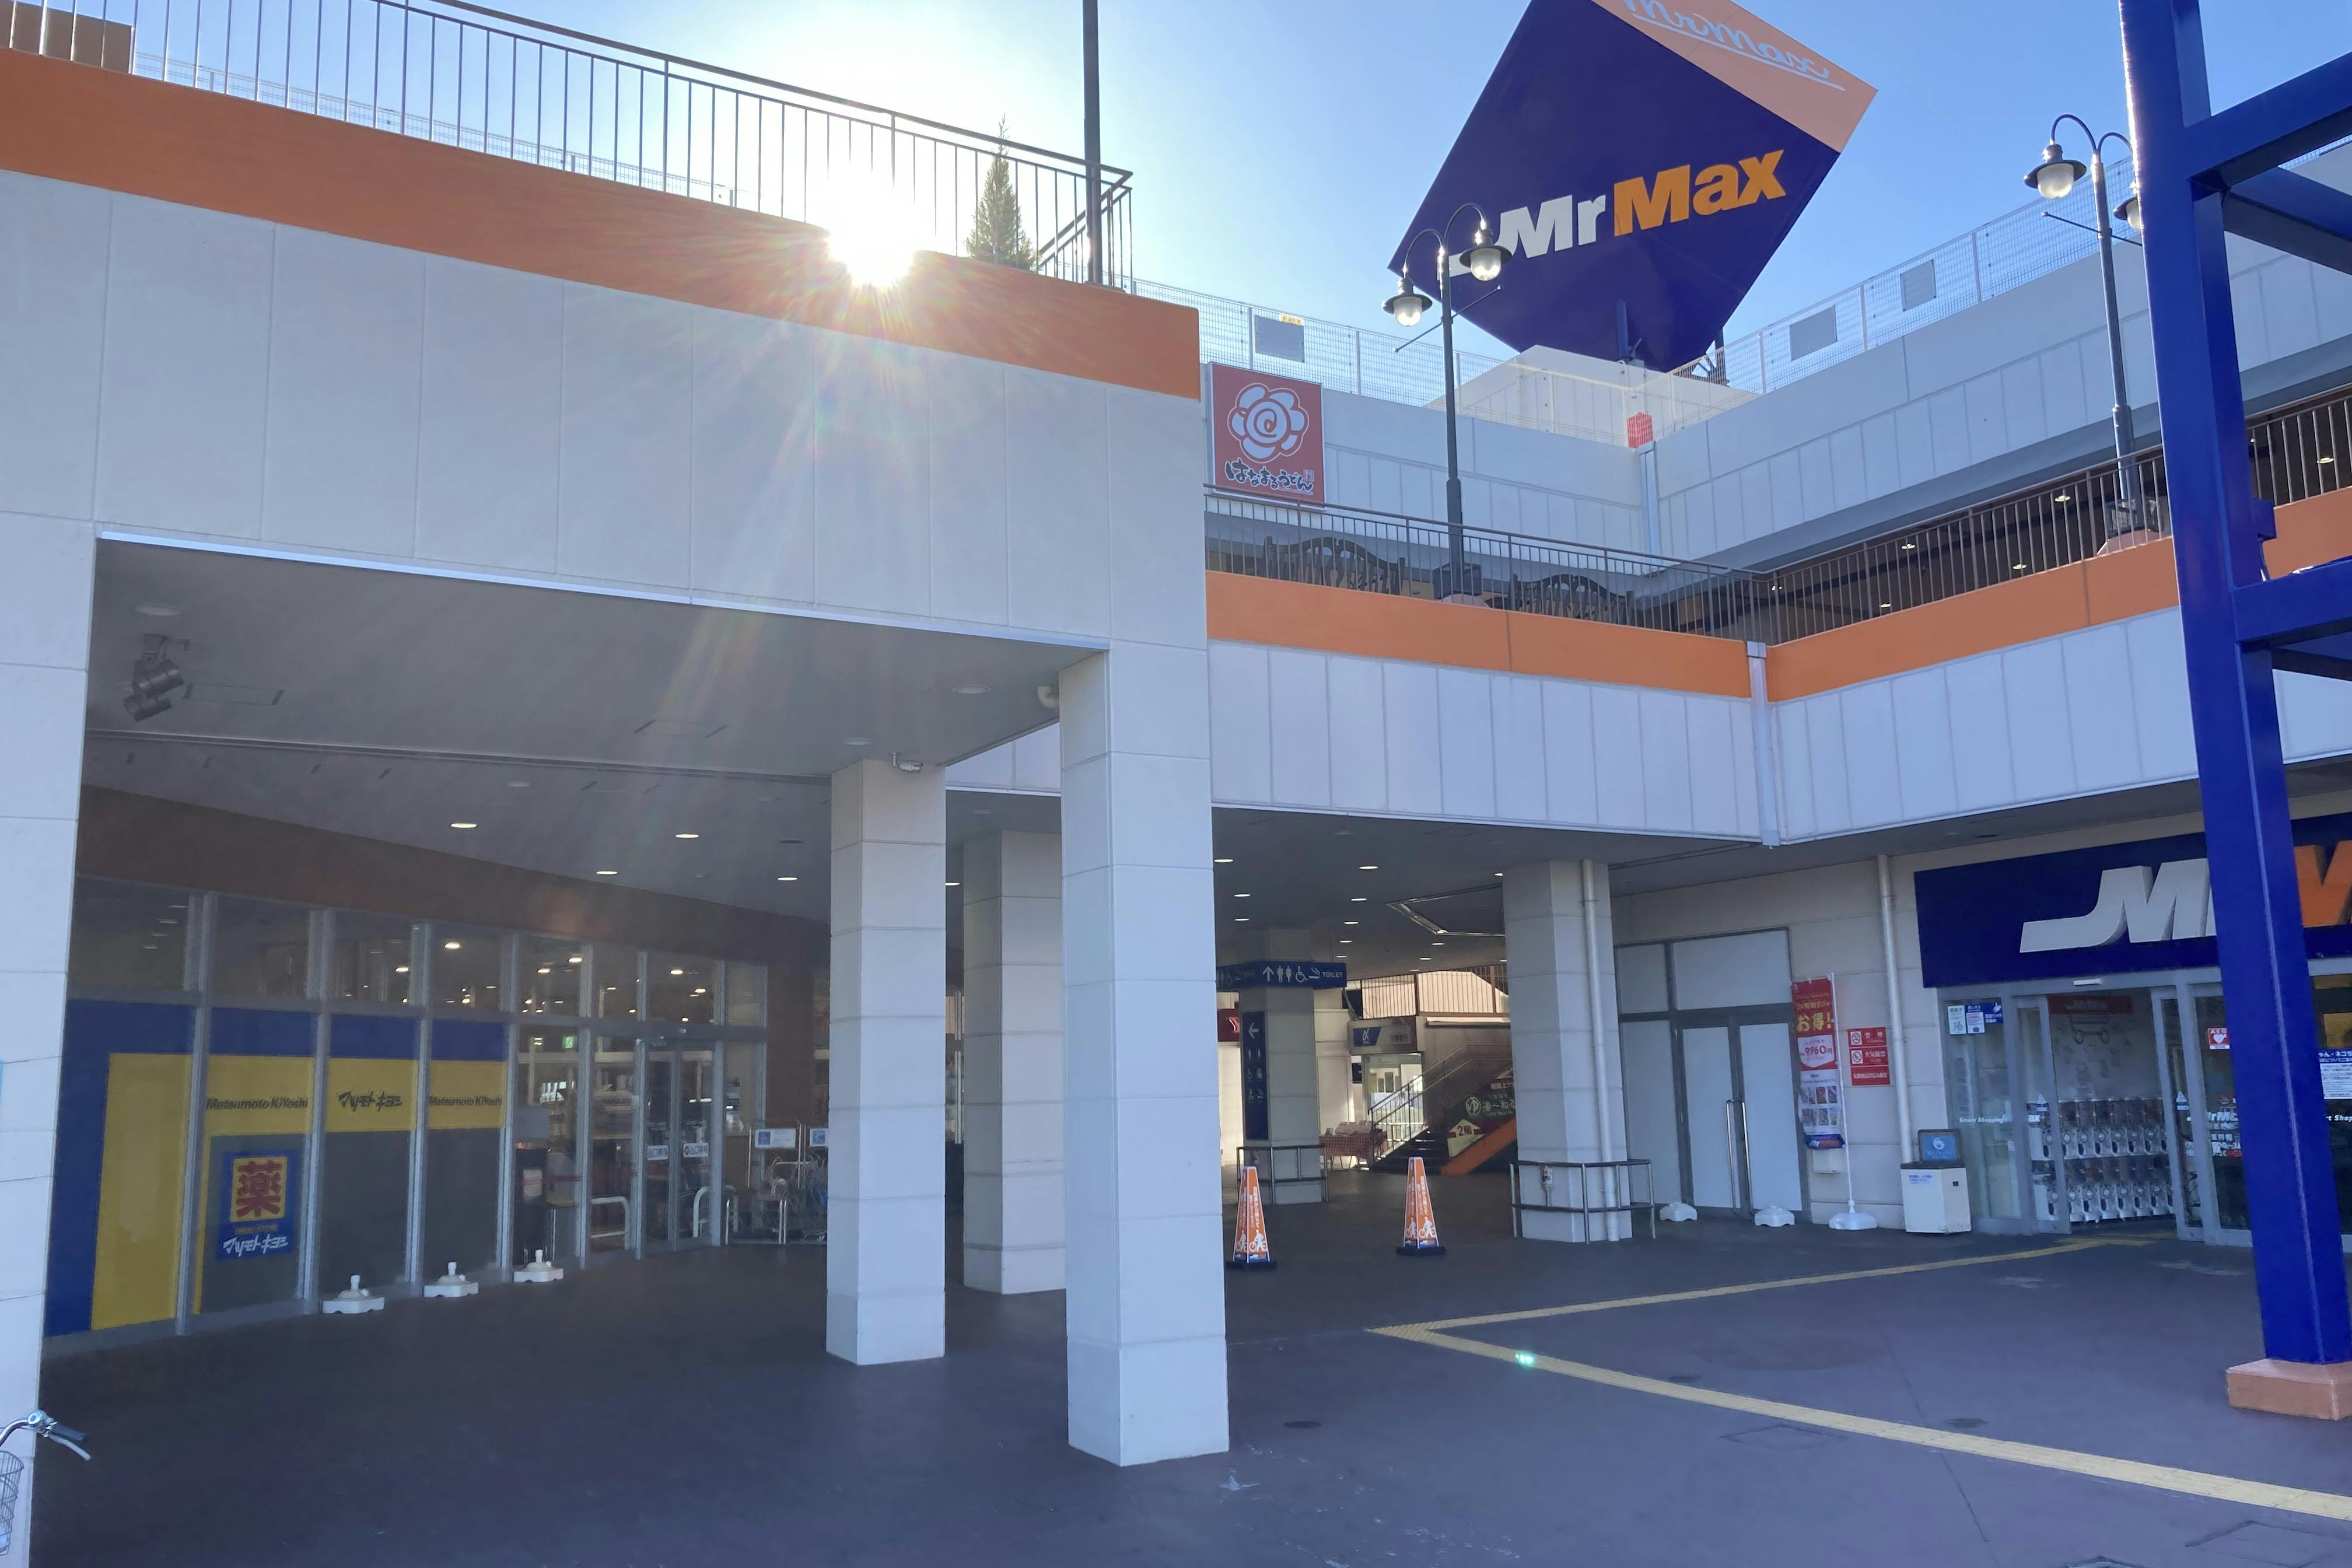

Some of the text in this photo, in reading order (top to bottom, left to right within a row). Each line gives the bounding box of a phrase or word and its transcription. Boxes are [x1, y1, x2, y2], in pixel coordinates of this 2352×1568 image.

[1437, 149, 1787, 281] MrMax
[1225, 458, 1313, 491] はなまるうどん
[206, 1097, 268, 1110] Matsumoto
[428, 1096, 474, 1107] Matsumoto
[236, 1160, 283, 1218] 薬
